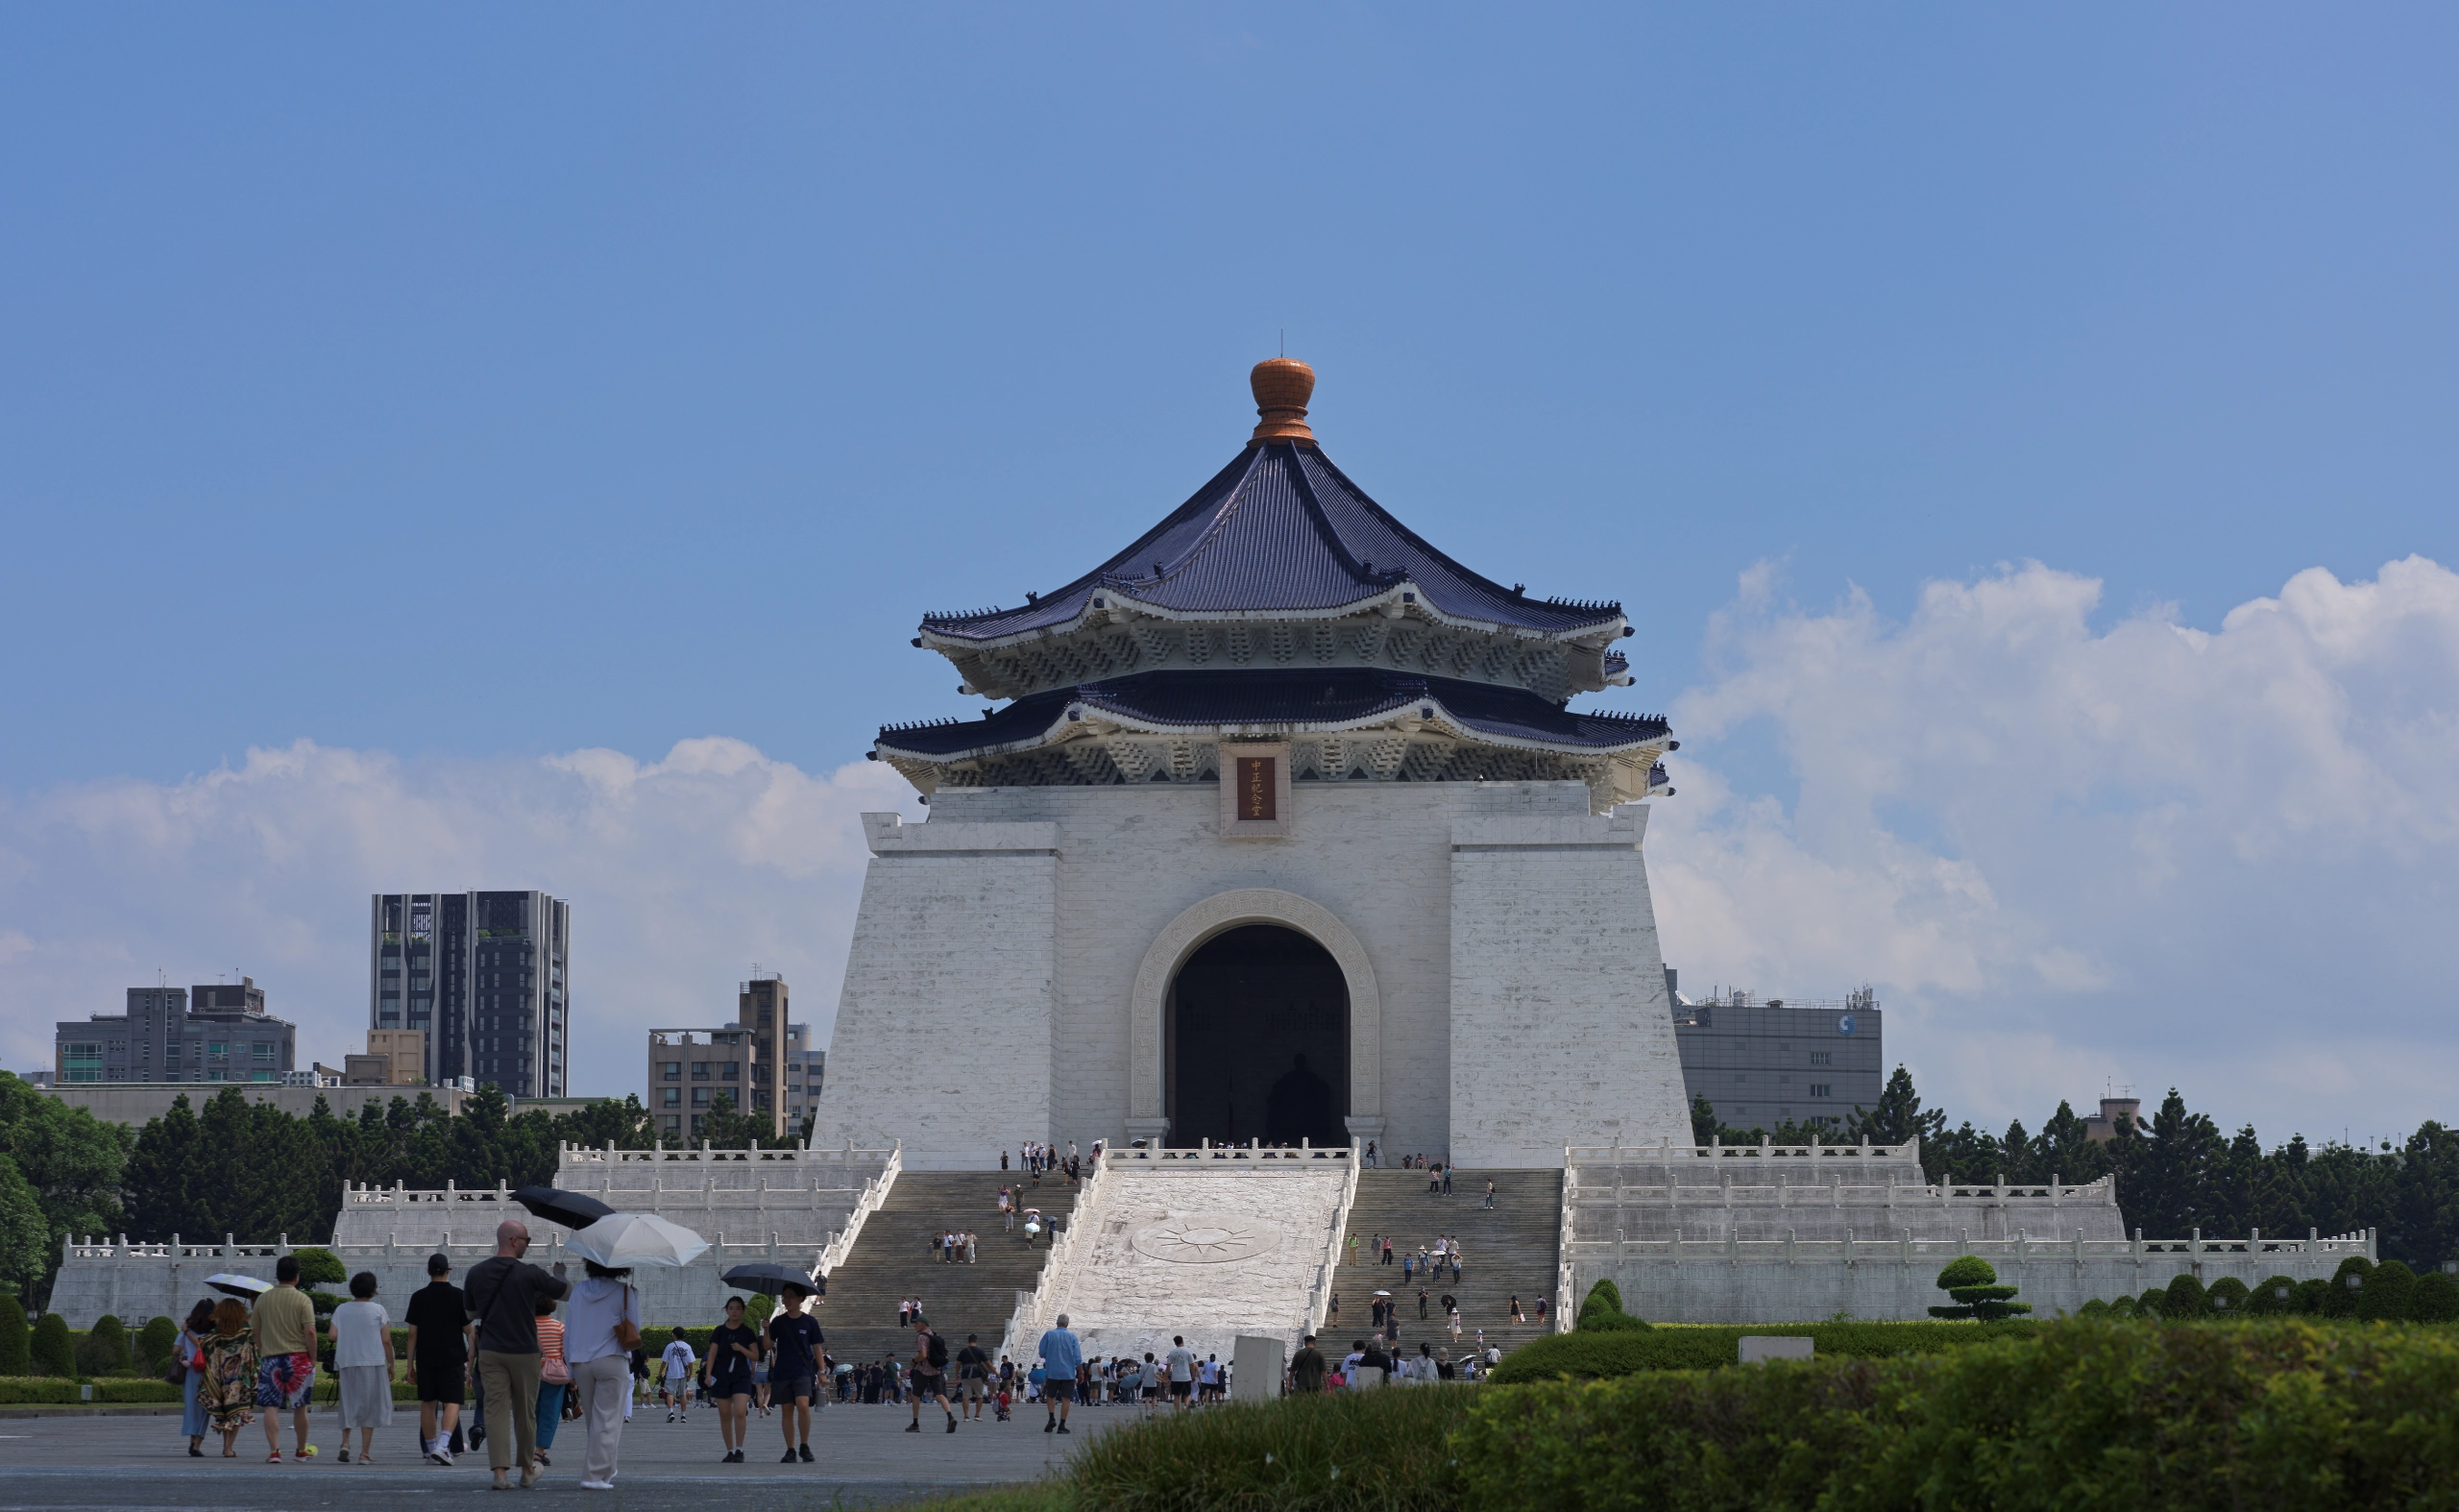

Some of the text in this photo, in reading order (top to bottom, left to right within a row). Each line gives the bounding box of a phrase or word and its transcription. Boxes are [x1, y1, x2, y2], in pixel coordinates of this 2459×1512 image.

[1251, 759, 1263, 817] 中正紀念堂
